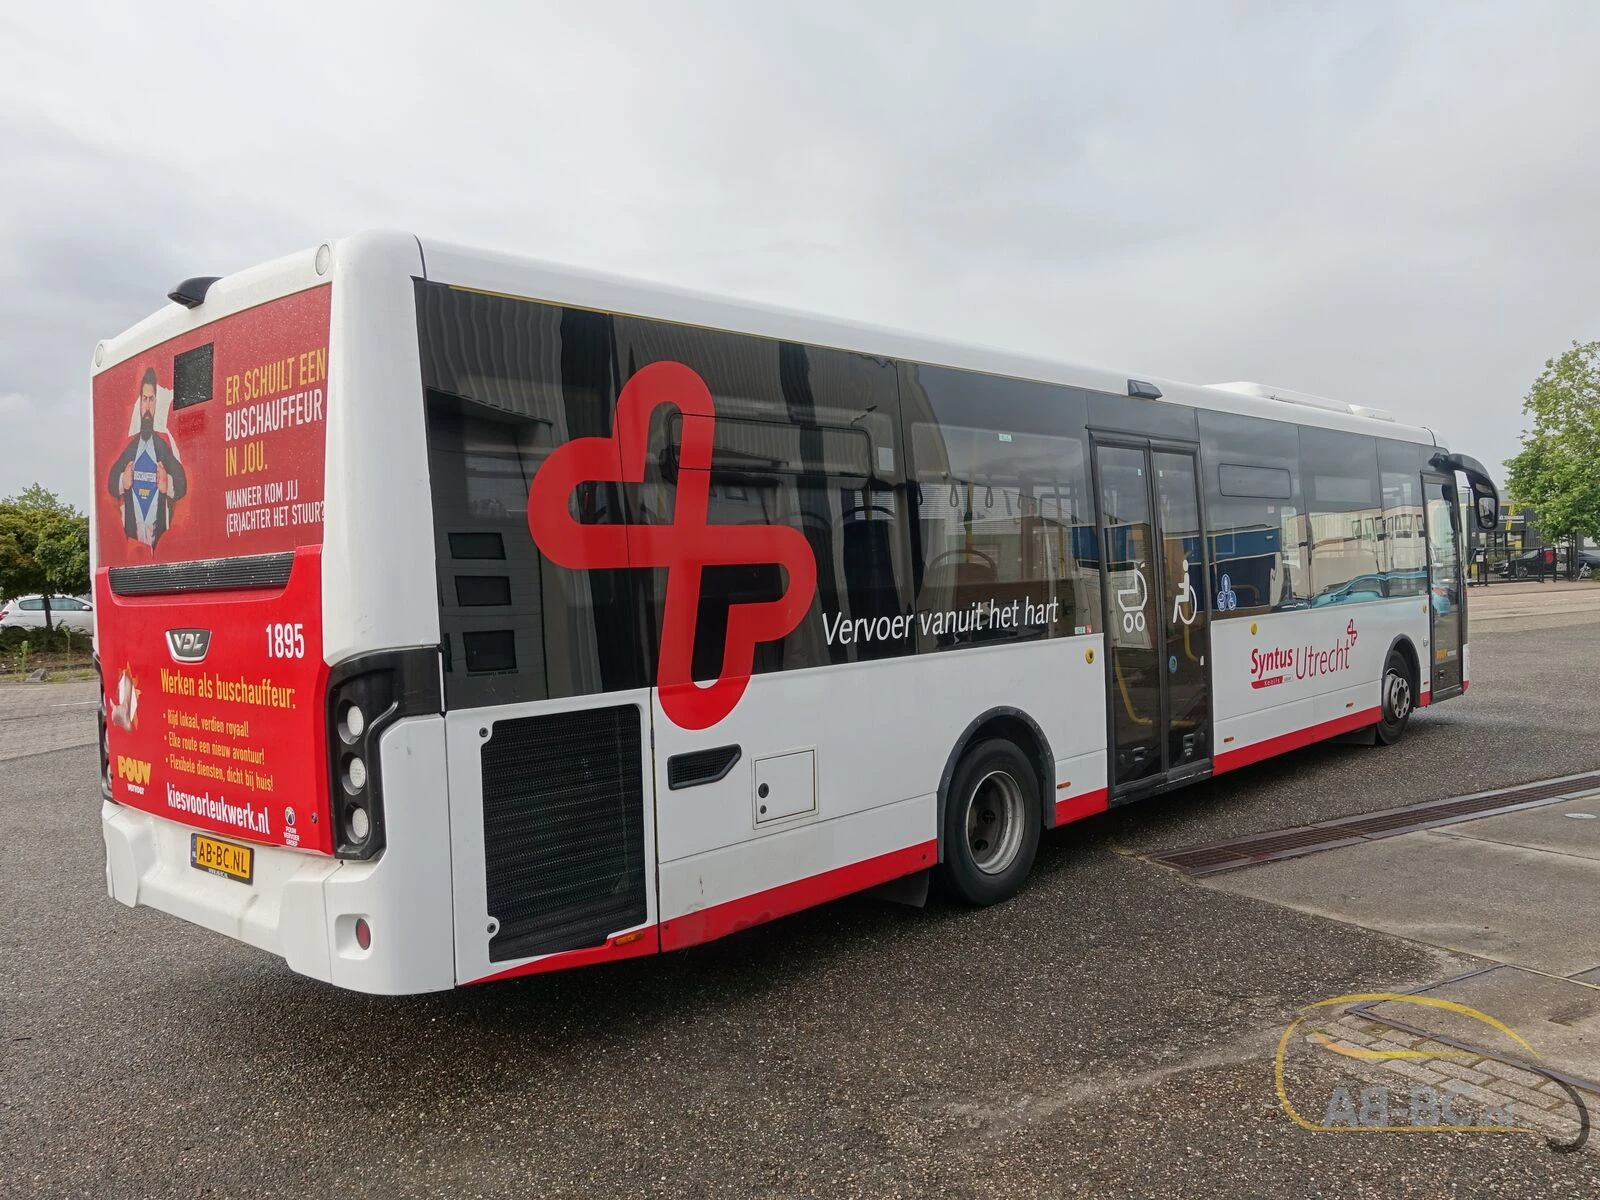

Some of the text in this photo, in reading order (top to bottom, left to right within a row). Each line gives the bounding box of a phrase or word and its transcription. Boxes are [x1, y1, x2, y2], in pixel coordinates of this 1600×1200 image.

[226, 347, 326, 406] ER SCHUILT EEN
[225, 388, 323, 442] BUSCHAUFFEUR
[225, 440, 268, 478] IN JOU.
[225, 479, 298, 510] WANNEER KOM JIJ
[226, 500, 325, 538] (ER)ACHTER HET STUUR?
[822, 595, 1059, 646] Vervoer vanuit het hart
[173, 633, 204, 651] VDL
[266, 623, 305, 659] 1895
[1250, 638, 1350, 680] Syntus Utrecht
[161, 667, 296, 709] Werken als buschauffeur:
[167, 709, 249, 740] Rijd lokaal, verdien royaal!
[169, 731, 265, 765] Elke route een nieuw avontuur!
[117, 754, 152, 786] POUW
[170, 753, 274, 792] Flexibele diensten, dicht bij huis!
[166, 782, 271, 835] kiesvoorleukwerk.nl
[198, 841, 247, 874] AB-BC.NL
